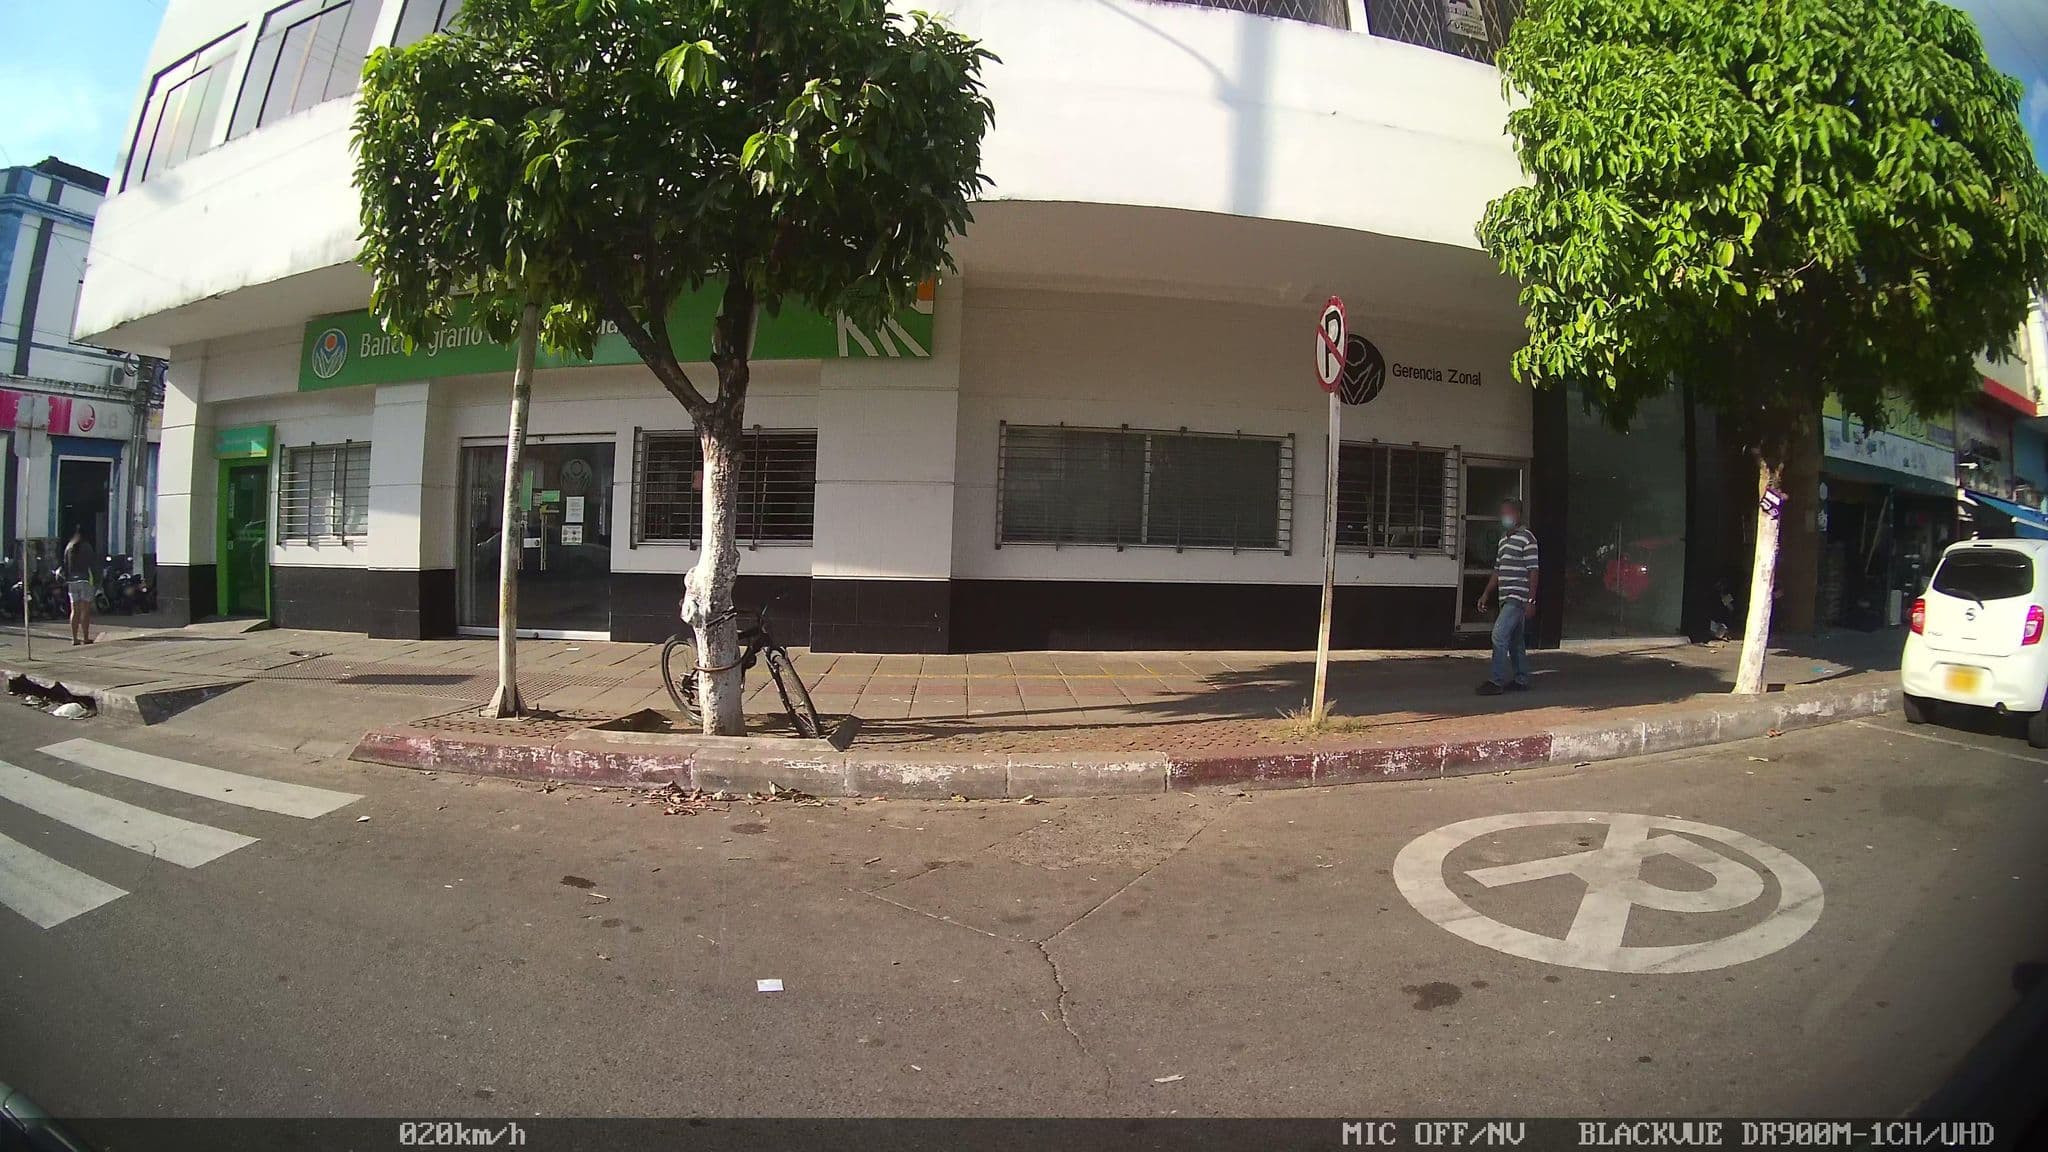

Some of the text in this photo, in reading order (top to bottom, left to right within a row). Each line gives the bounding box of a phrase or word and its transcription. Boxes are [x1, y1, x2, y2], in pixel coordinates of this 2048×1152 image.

[414, 324, 483, 357] grario
[1392, 363, 1482, 386] Gerencia Zonal
